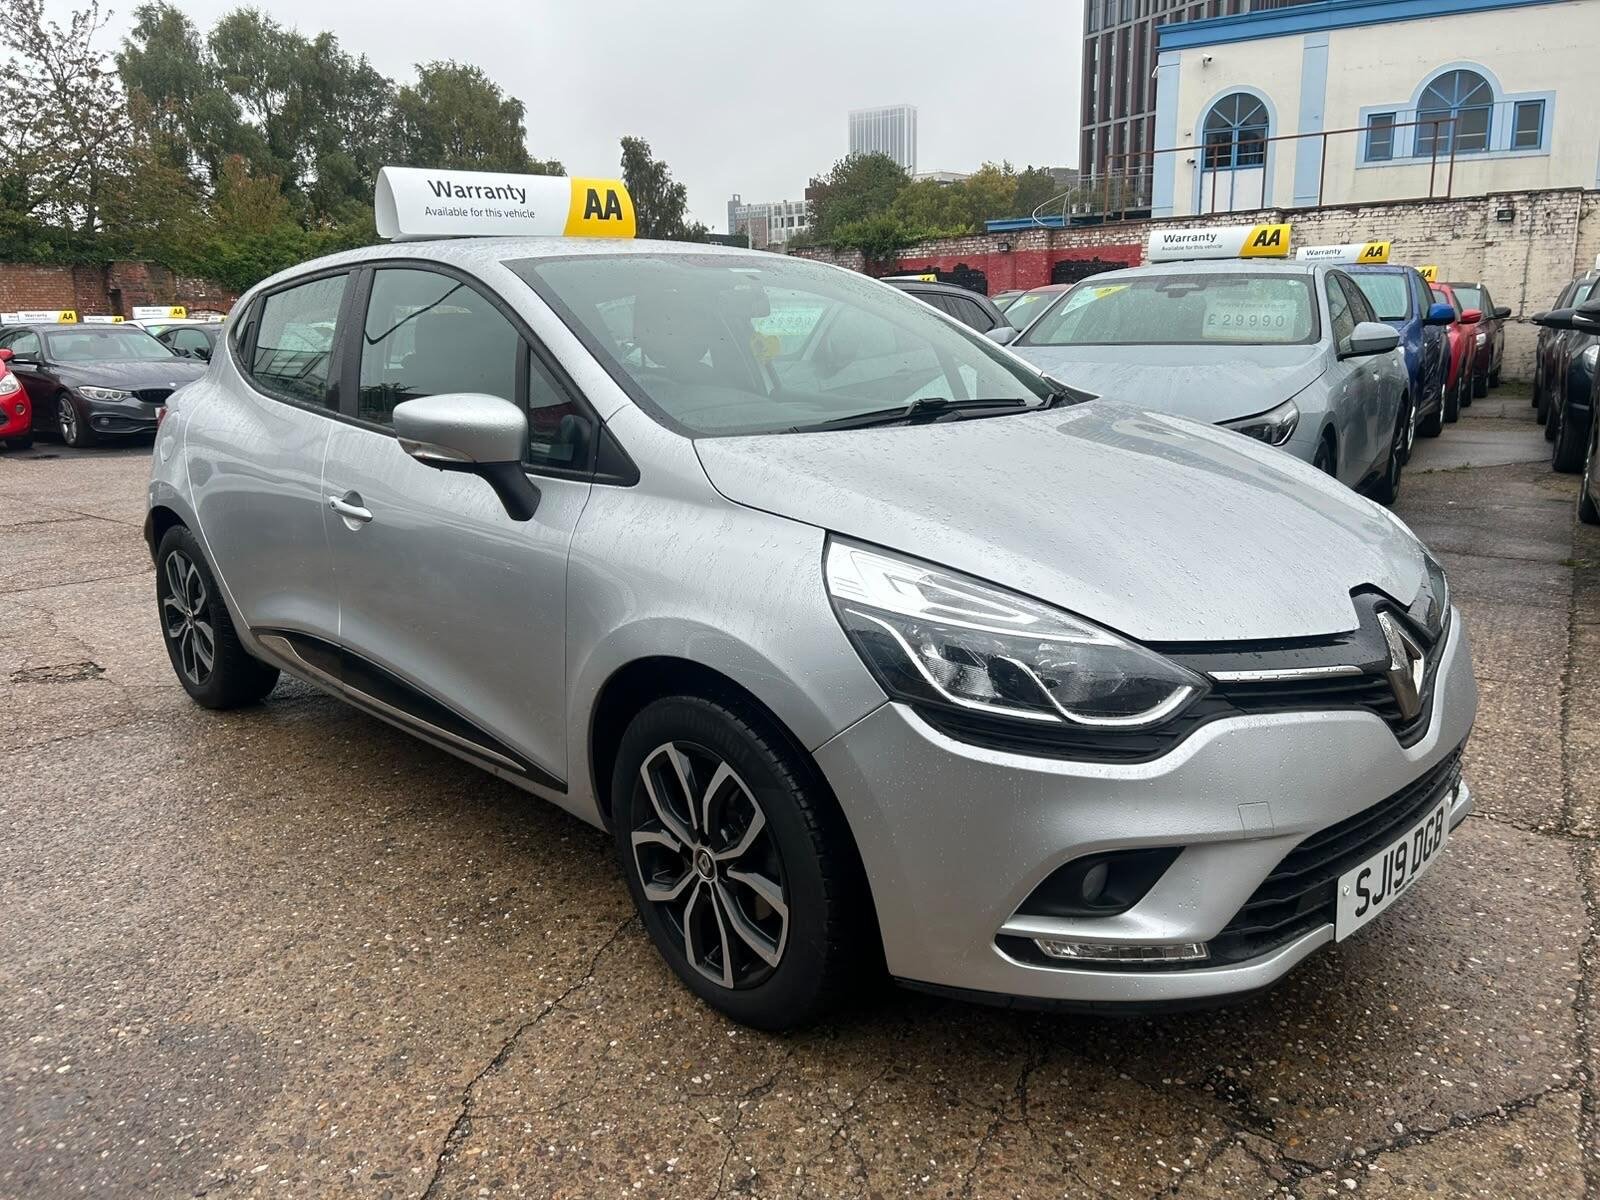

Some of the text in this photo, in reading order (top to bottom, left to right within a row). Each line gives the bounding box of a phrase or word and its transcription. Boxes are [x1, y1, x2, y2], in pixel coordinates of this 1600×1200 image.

[427, 179, 526, 204] Warranty
[584, 188, 622, 220] AA
[425, 206, 535, 219] Available for this vehicle
[1164, 233, 1217, 243] Warranty
[1252, 229, 1281, 247] AA
[1306, 248, 1342, 256] Warranty
[1365, 245, 1384, 257] AA
[62, 312, 73, 320] AA
[1355, 806, 1444, 918] SJ19 DGB
